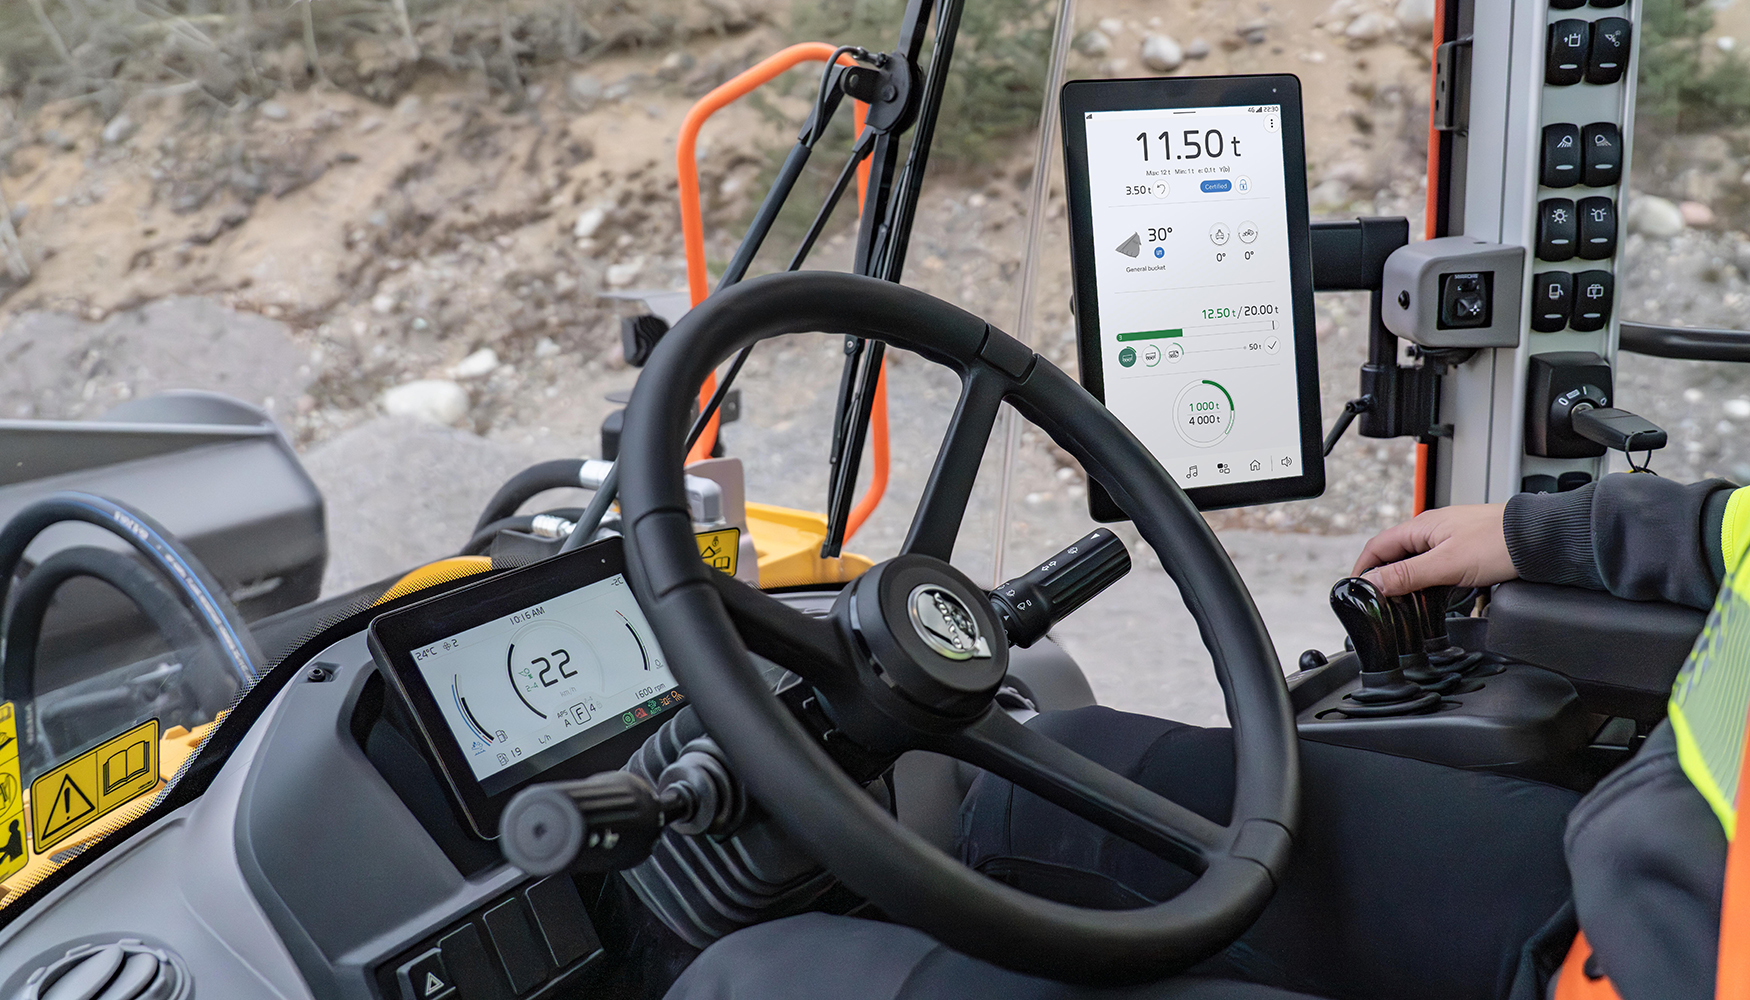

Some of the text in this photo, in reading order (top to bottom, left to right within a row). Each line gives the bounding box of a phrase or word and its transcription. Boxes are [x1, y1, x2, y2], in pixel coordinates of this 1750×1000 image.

[1136, 129, 1242, 162] 11.50 t
[1126, 186, 1147, 196] 3.50
[1148, 227, 1173, 242] 30°
[1202, 307, 1230, 319] 12.50
[510, 606, 546, 625] 10:16 AM
[934, 592, 963, 649] VOLVO
[451, 639, 459, 647] 2
[415, 646, 437, 660] 24°C
[531, 648, 578, 688] 22
[525, 682, 539, 692] 2-4
[634, 683, 666, 700] 1600 rpm
[557, 709, 568, 718] APS
[576, 707, 584, 720] F
[590, 703, 596, 712] 4
[564, 719, 572, 728] A
[511, 747, 522, 758] 19
